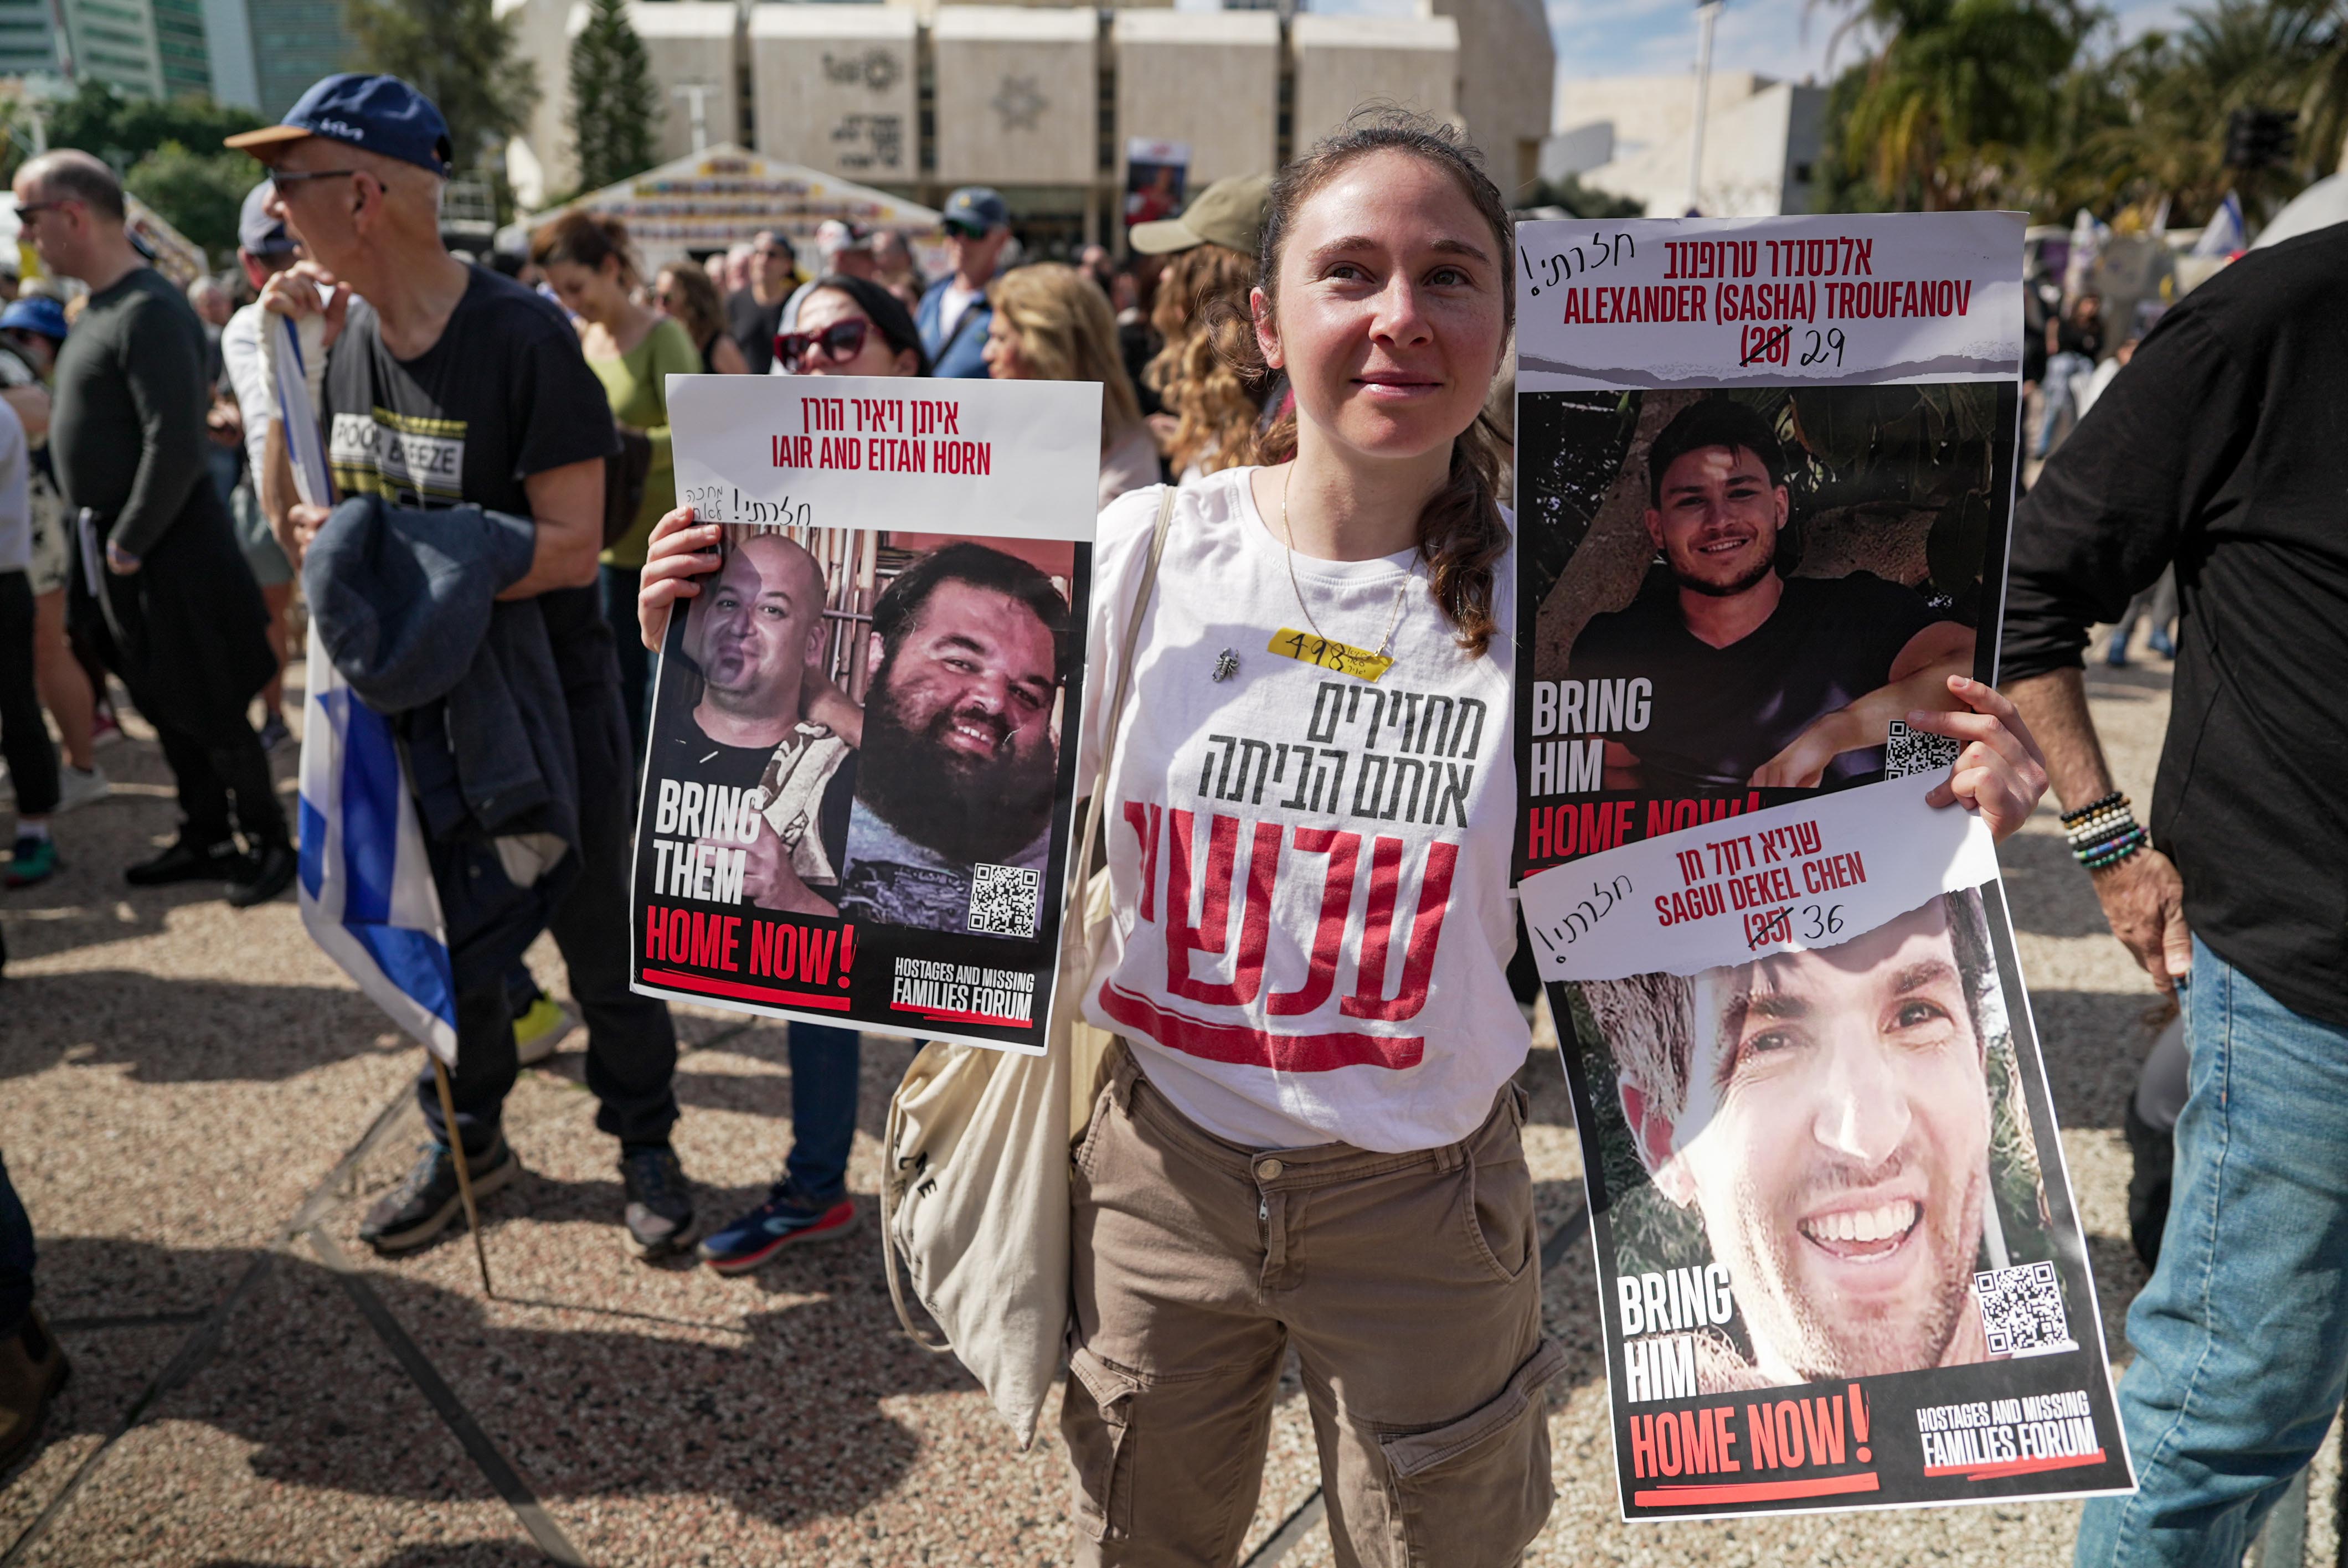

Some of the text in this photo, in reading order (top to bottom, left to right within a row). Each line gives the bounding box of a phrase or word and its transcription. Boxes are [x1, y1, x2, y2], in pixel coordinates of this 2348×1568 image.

[1665, 238, 1872, 278] אלכסנדר טרופנוב
[1566, 281, 1970, 324] ALEXANDER (SASHA) TROUFANOV
[1742, 324, 1789, 365] (28)
[1800, 328, 1845, 367] 29
[802, 398, 958, 437] איתן ויאיר הורן
[773, 436, 990, 474] IAIR AND EITAN HORN
[734, 488, 811, 525] חזרתי!
[1286, 633, 1345, 671] 498
[1307, 682, 1486, 759] מחזירים
[1532, 677, 1652, 735] BRING
[1198, 735, 1474, 828] אותם הביתה
[1531, 740, 1603, 795] HIM
[656, 779, 764, 844] BRING
[1529, 801, 1635, 859] HOME
[653, 839, 746, 905] THEM
[1677, 821, 1821, 885] שגיא דקל חן
[1655, 852, 1866, 926] SAGUI DEKEL CHEN
[646, 905, 859, 989] HOME NOW!
[1744, 907, 1791, 950] (35)
[1803, 905, 1843, 938] 36
[893, 980, 1032, 1021] FAMILIES FORUM
[895, 957, 1034, 992] HOSTAGES AND MISSING
[1617, 1264, 1732, 1335] BRING
[1625, 1335, 1697, 1402] HIM
[1630, 1384, 1872, 1478] HOME NOW!
[1917, 1390, 2090, 1432] HOSTAGES AND MISSING
[1921, 1416, 2099, 1468] FAMILIES FORUM
